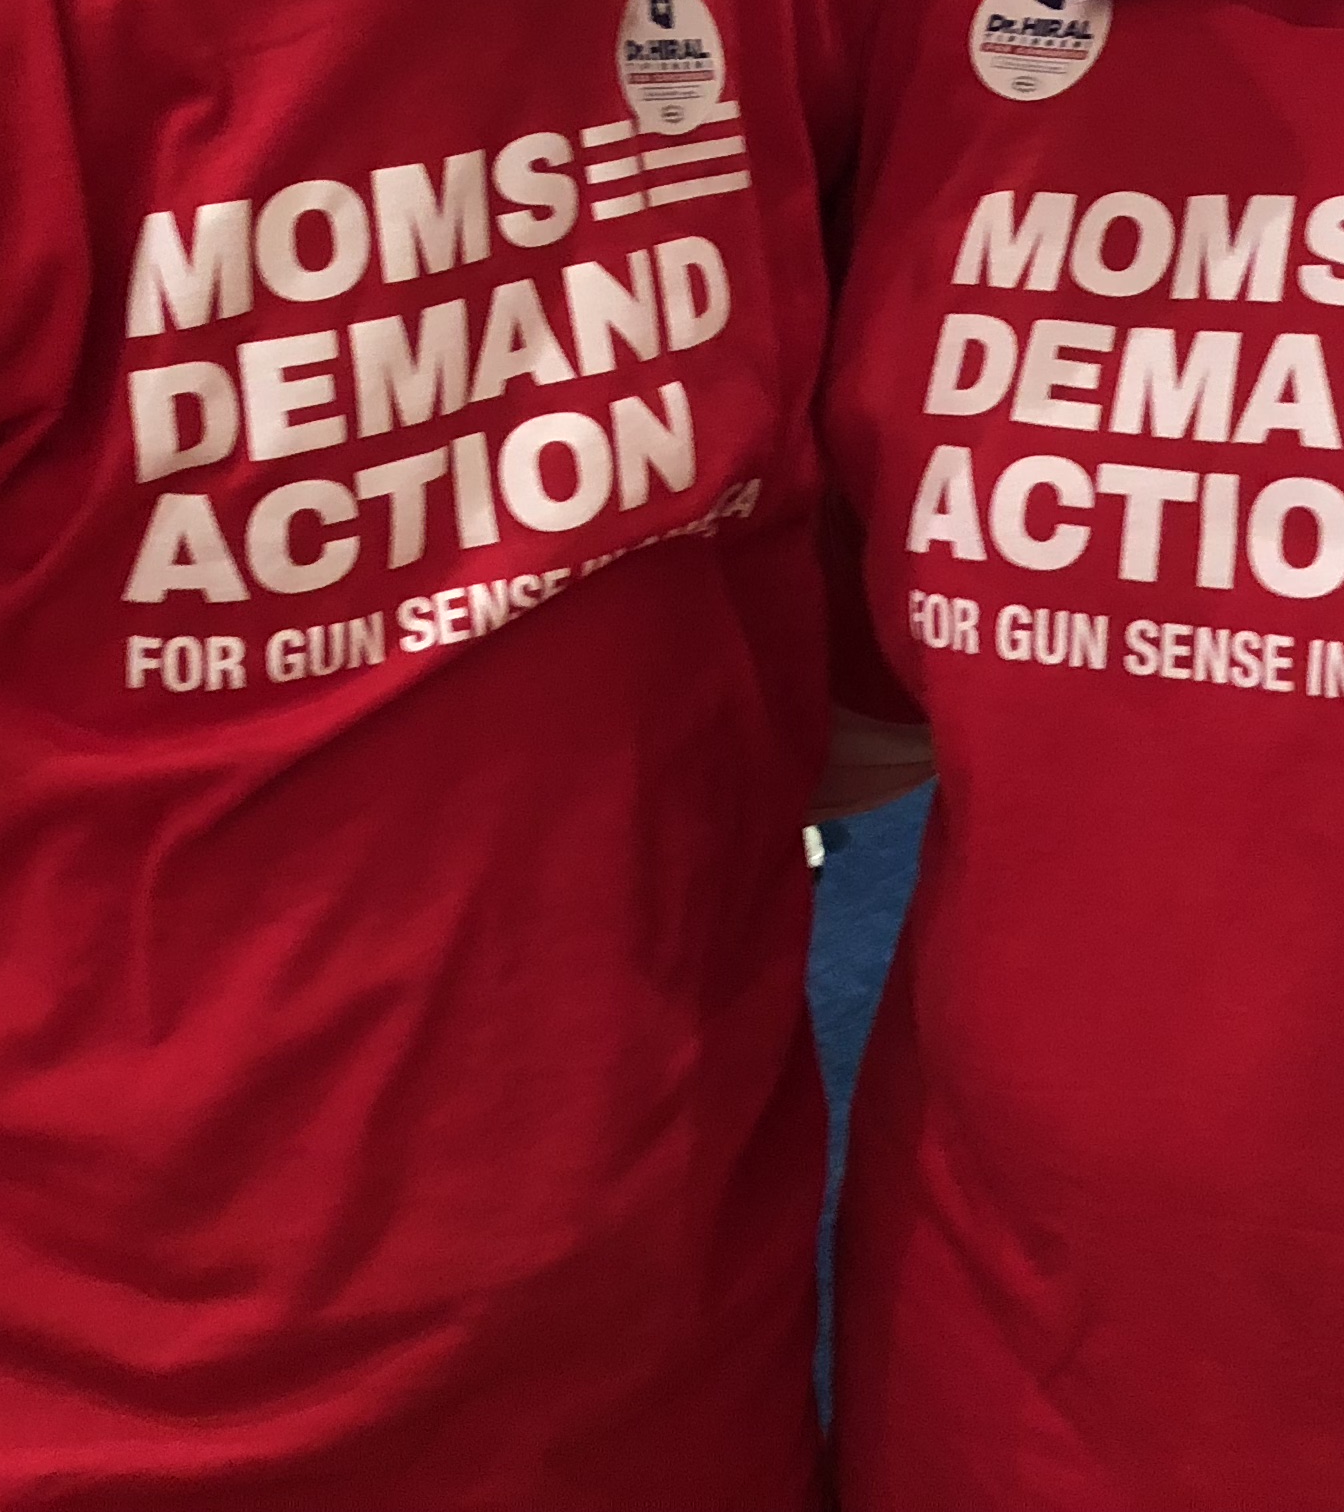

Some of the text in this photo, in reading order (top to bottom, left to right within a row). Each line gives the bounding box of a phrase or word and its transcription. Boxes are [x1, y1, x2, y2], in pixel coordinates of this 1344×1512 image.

[126, 131, 578, 338] MOMS
[127, 235, 731, 484] DEMAND
[122, 380, 697, 604] ACTION
[126, 634, 246, 692] FOR
[265, 611, 386, 683] GUN
[908, 589, 981, 655] FOR
[995, 603, 1110, 670] GUN
[1124, 619, 1295, 693] SENSE
